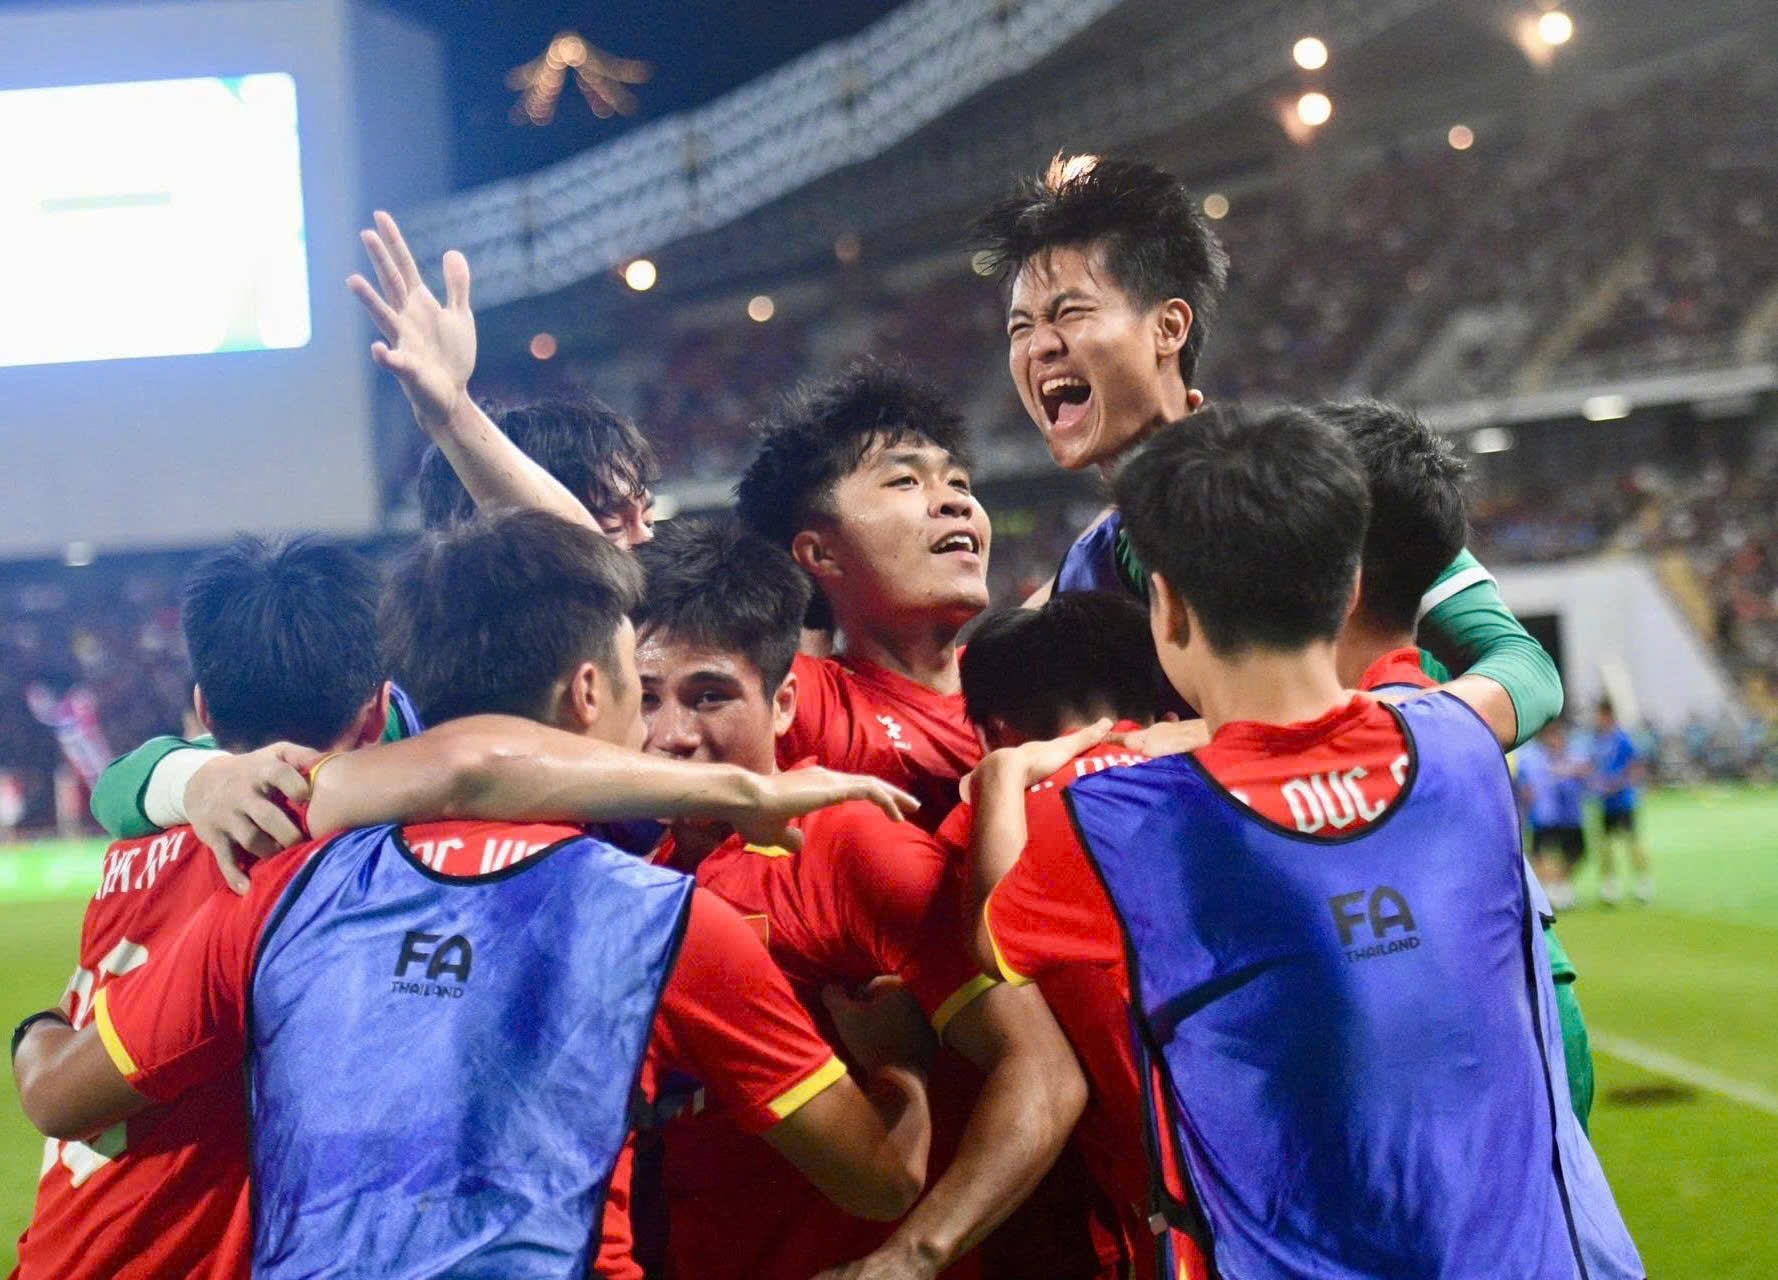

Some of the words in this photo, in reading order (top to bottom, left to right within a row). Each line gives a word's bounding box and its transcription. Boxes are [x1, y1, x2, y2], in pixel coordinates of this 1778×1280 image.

[1281, 766, 1387, 834] DUC
[1328, 885, 1416, 946] FA
[394, 931, 473, 983] FA
[1344, 936, 1421, 963] THAILAND
[391, 981, 464, 999] THAILAND
